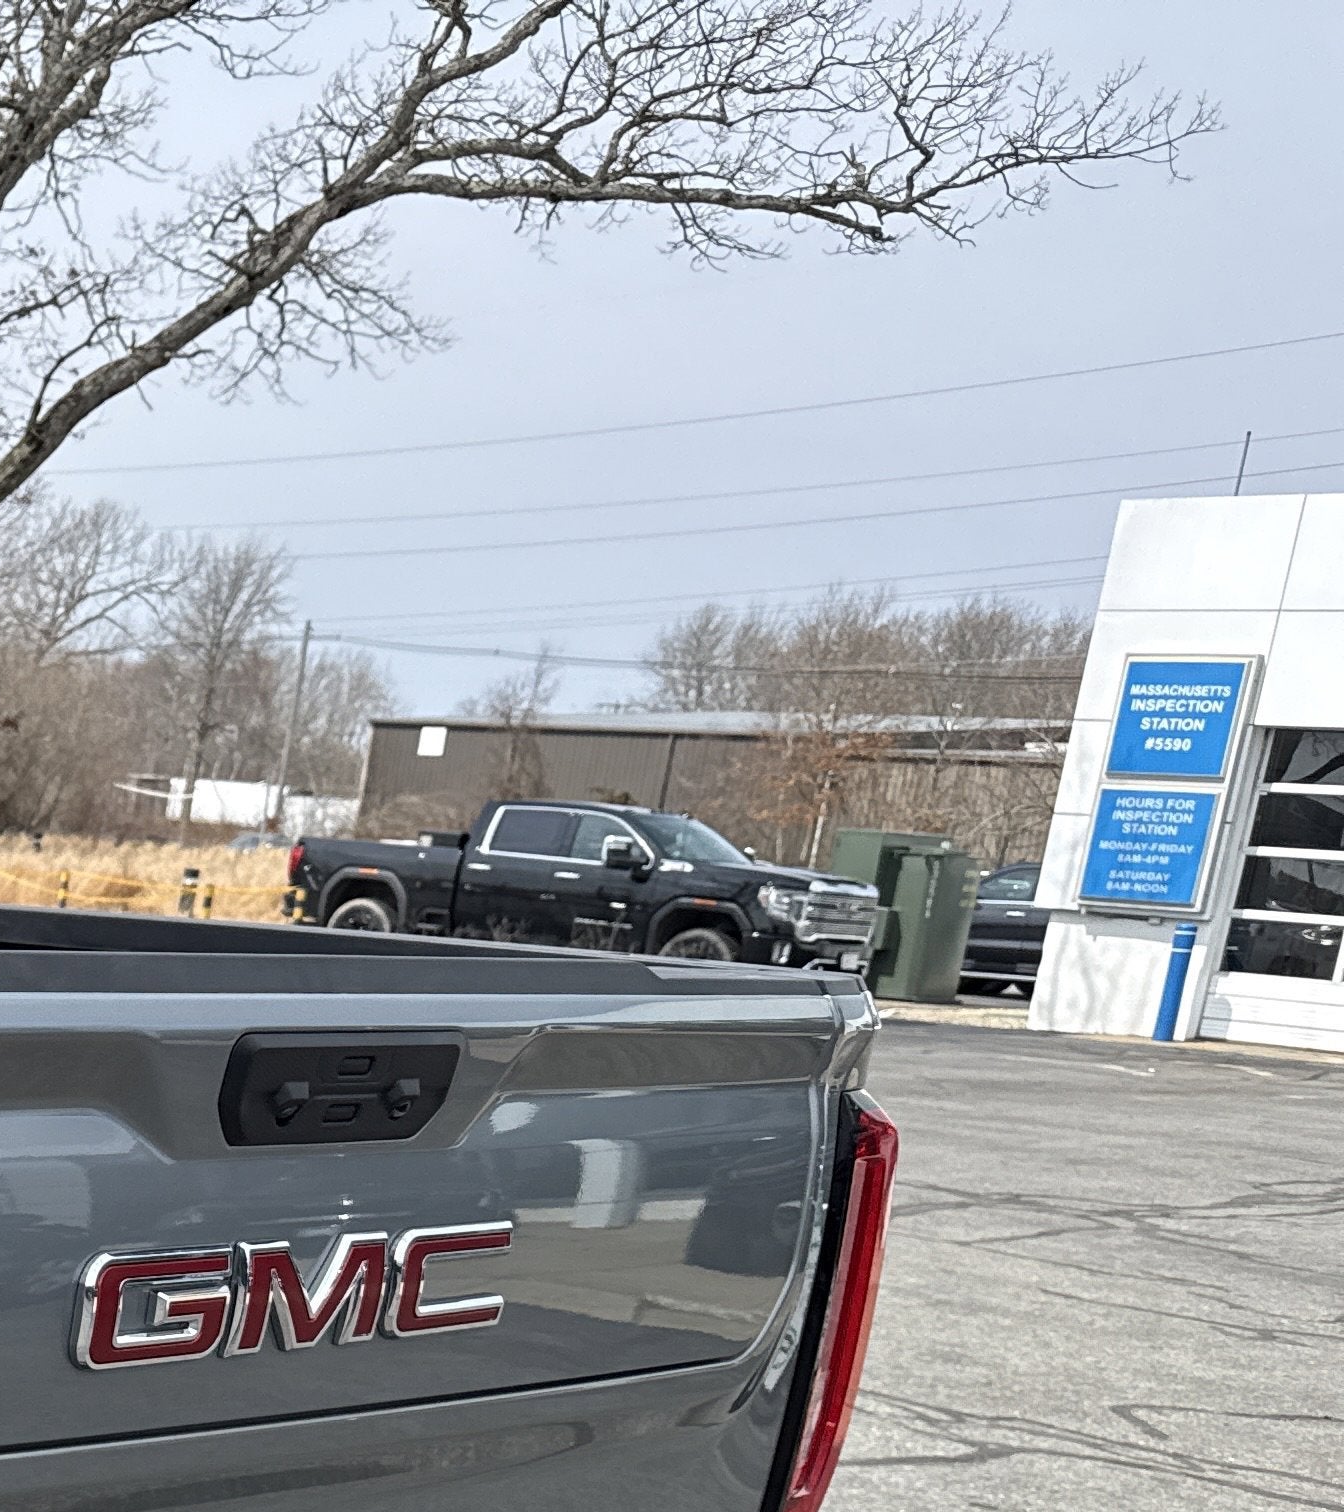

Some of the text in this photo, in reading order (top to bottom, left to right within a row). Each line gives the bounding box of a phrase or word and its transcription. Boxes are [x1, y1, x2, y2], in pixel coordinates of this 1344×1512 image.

[1130, 684, 1231, 697] MASSACHUSETTS
[1130, 698, 1224, 713] INSPECTION
[1139, 717, 1206, 731] STATION
[1144, 738, 1192, 751] #5590
[1116, 796, 1196, 811] HOURS FOR
[1112, 810, 1194, 824] INSPECTION
[1121, 822, 1178, 836] STATION
[1108, 870, 1171, 882] SATURDAY
[68, 1220, 513, 1370] GMC
